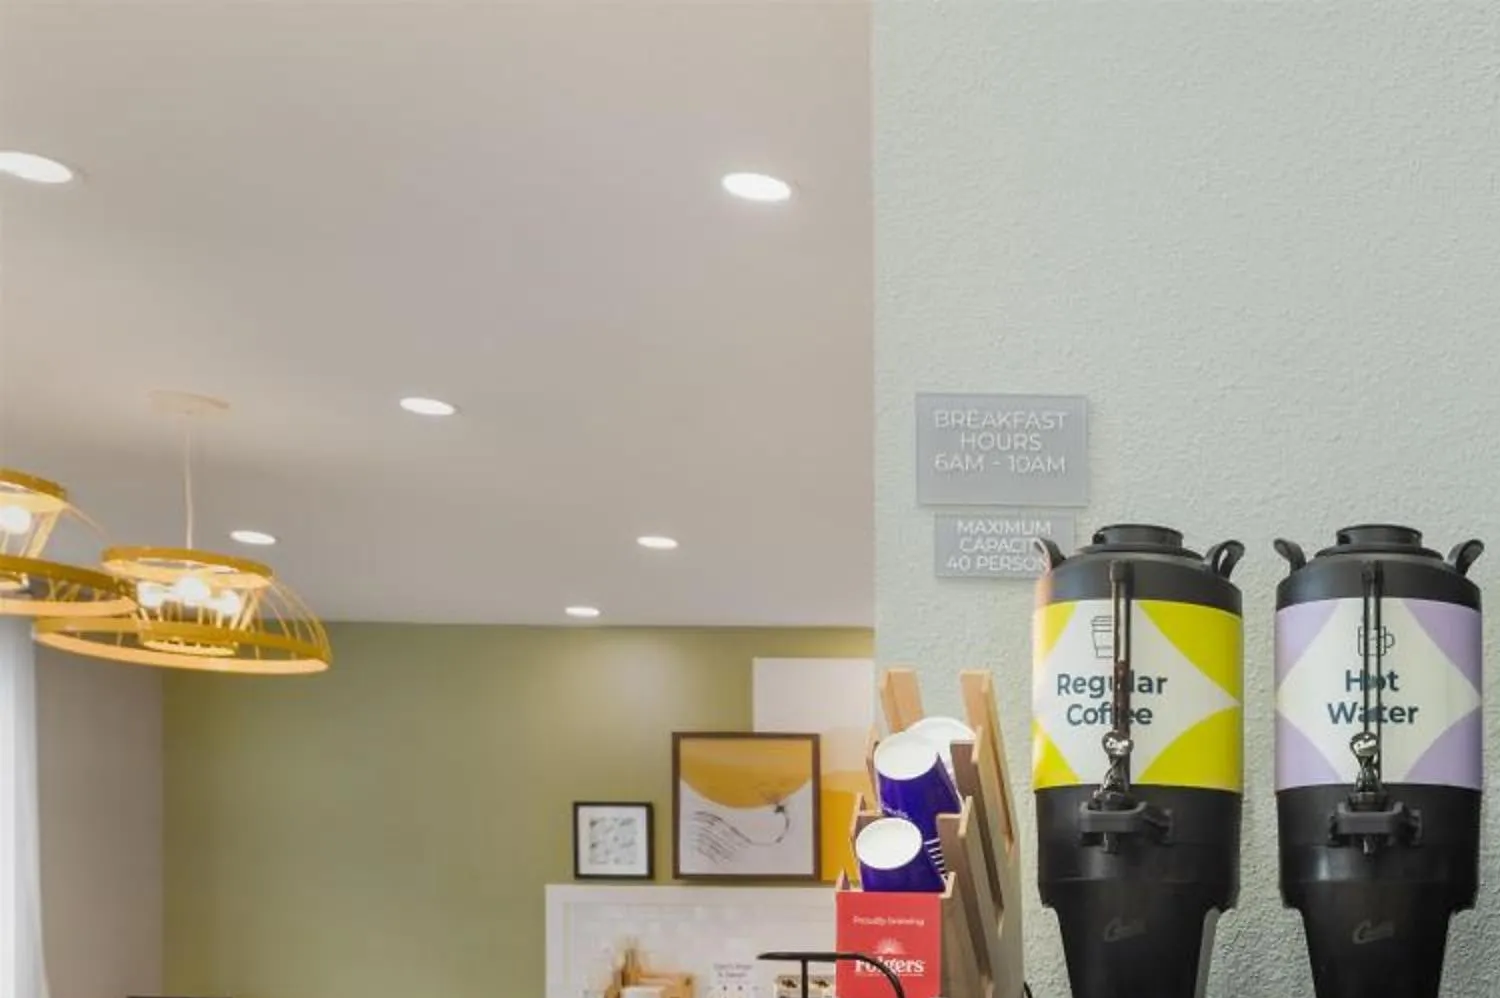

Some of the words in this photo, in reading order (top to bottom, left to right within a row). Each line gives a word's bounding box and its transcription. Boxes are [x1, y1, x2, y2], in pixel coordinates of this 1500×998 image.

[933, 409, 1069, 430] BREAKFAST
[960, 432, 1043, 452] HOURS
[933, 452, 985, 473] 6AM
[1007, 454, 1067, 475] 10AM
[955, 519, 1052, 536] MAXIMUM
[958, 537, 1042, 553] CAPACIT
[946, 556, 971, 571] 40
[975, 555, 1050, 572] PERSON
[1345, 669, 1400, 693] Hot
